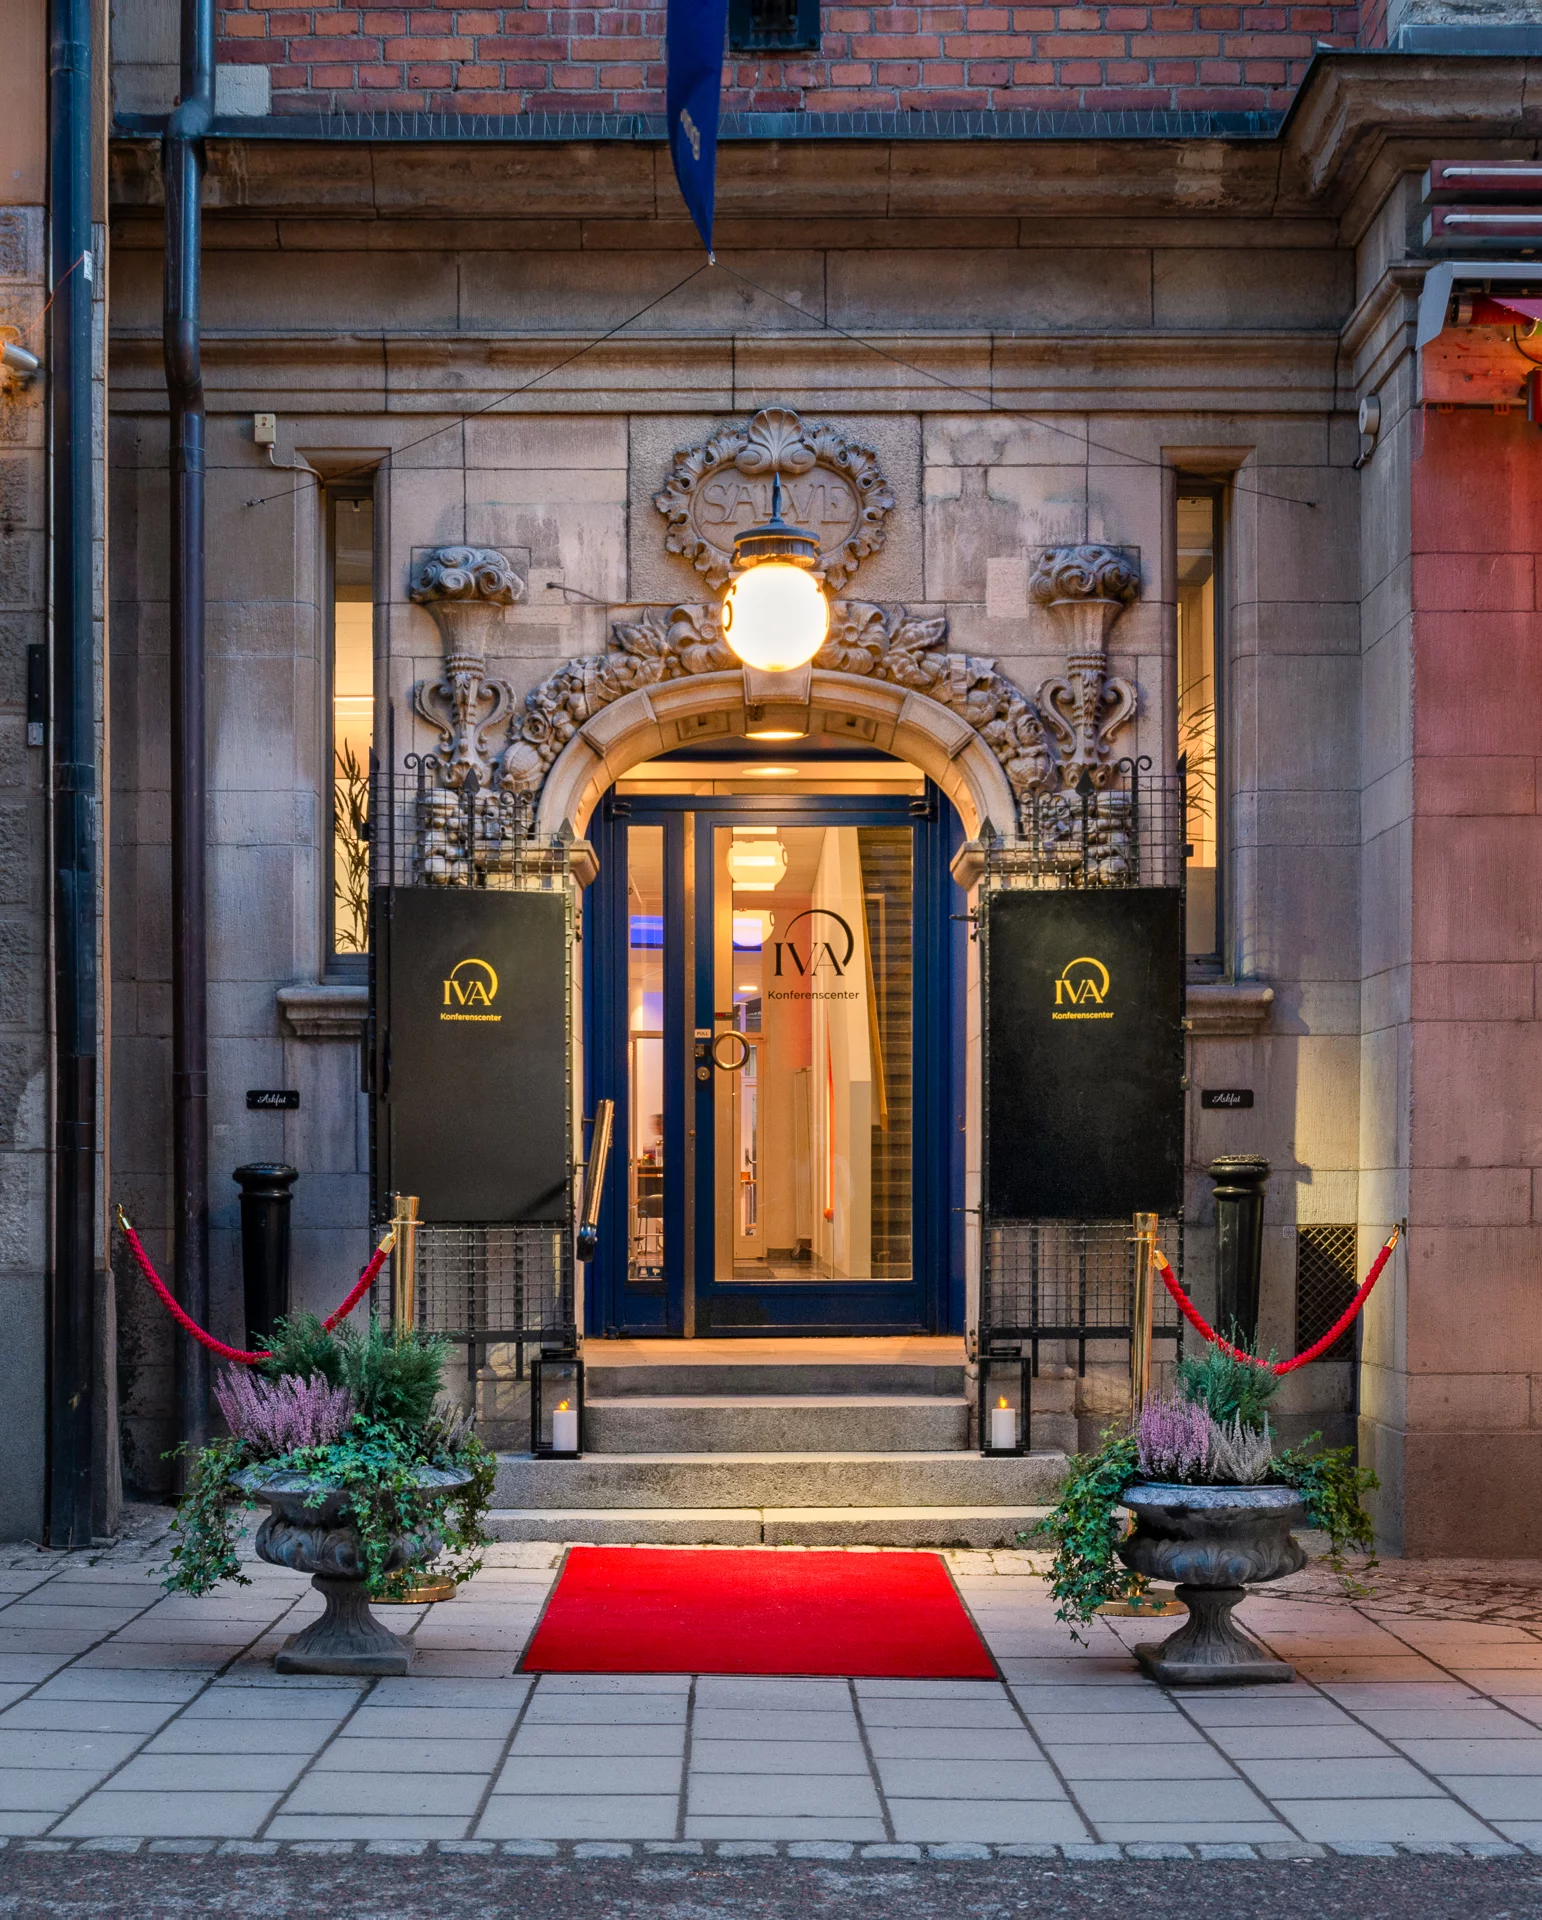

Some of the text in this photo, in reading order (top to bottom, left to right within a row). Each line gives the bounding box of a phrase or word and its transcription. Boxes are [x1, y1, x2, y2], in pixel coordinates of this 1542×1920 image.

[702, 482, 851, 524] SALVE
[773, 942, 845, 977] IVA
[443, 980, 492, 1006] IVA
[767, 990, 860, 1000] Konferenscenter
[1054, 979, 1104, 1005] IVA
[440, 1012, 502, 1022] Konferenscenter
[1051, 1011, 1115, 1020] Konferenscenter
